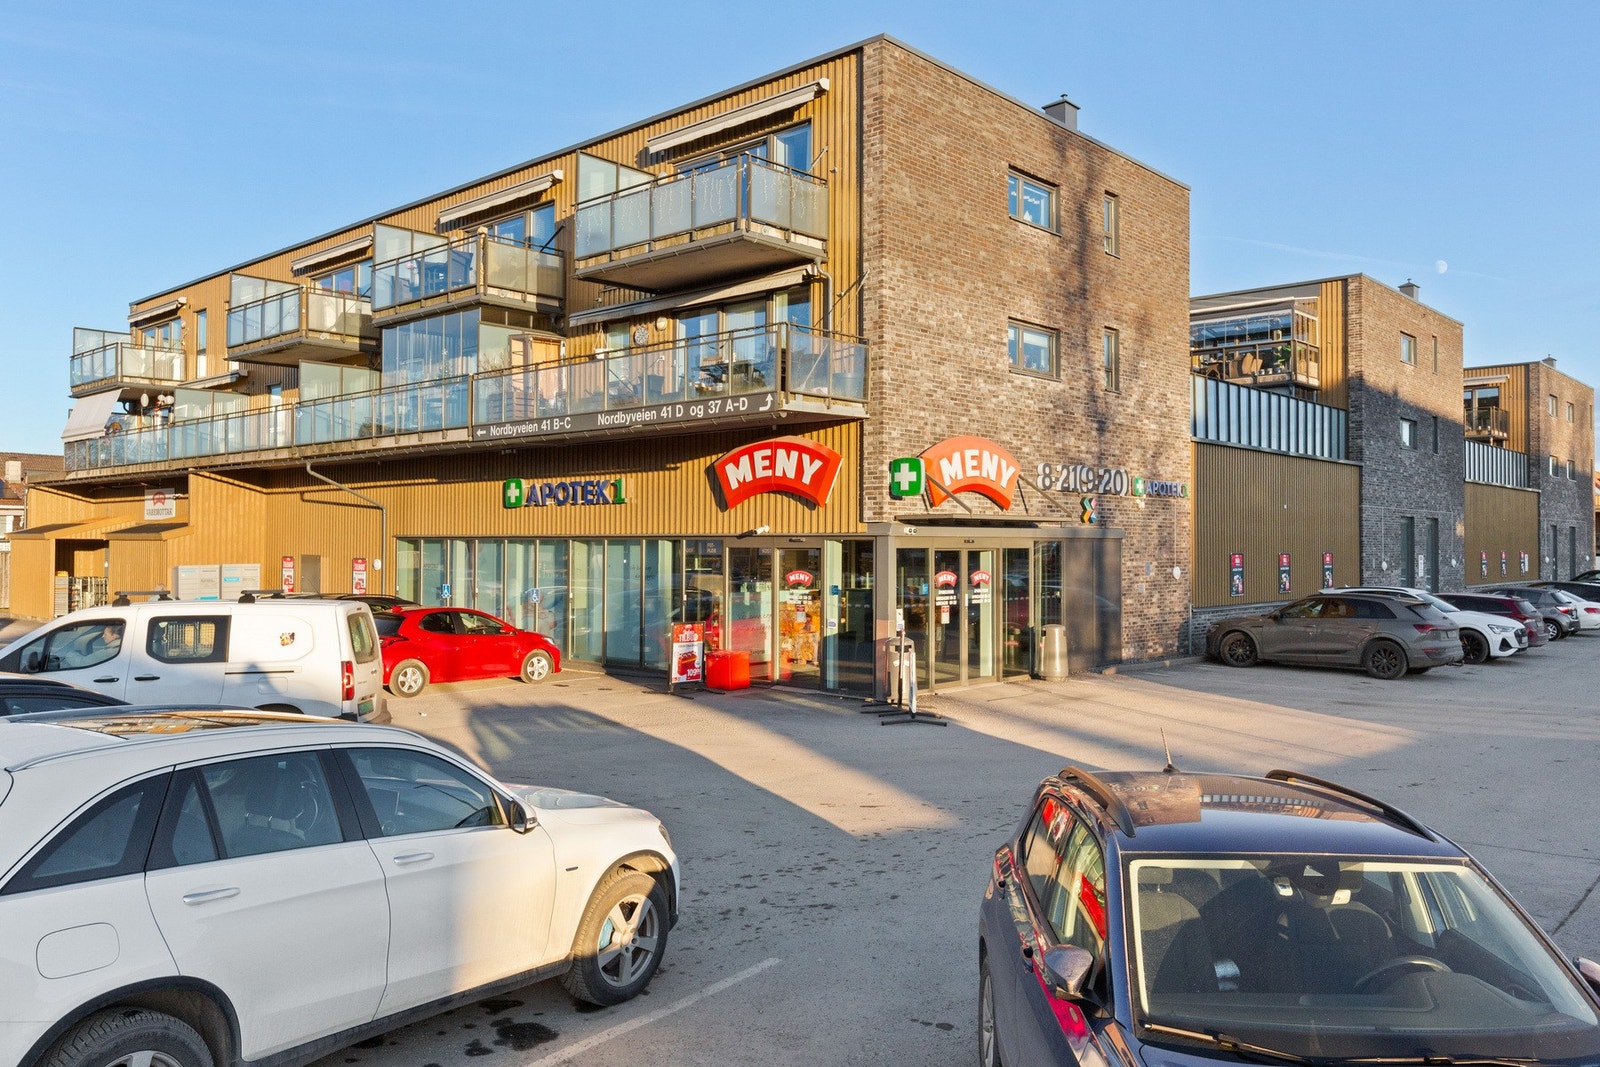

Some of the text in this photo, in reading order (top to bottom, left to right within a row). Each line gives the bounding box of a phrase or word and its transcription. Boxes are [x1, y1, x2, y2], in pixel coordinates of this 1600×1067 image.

[597, 397, 748, 426] Nordbyveien 41 D og 37 A-D
[490, 416, 572, 437] Nordbyveien 41 B-C
[724, 448, 823, 491] MENY
[939, 449, 1016, 489] MENY
[788, 573, 810, 582] MENY
